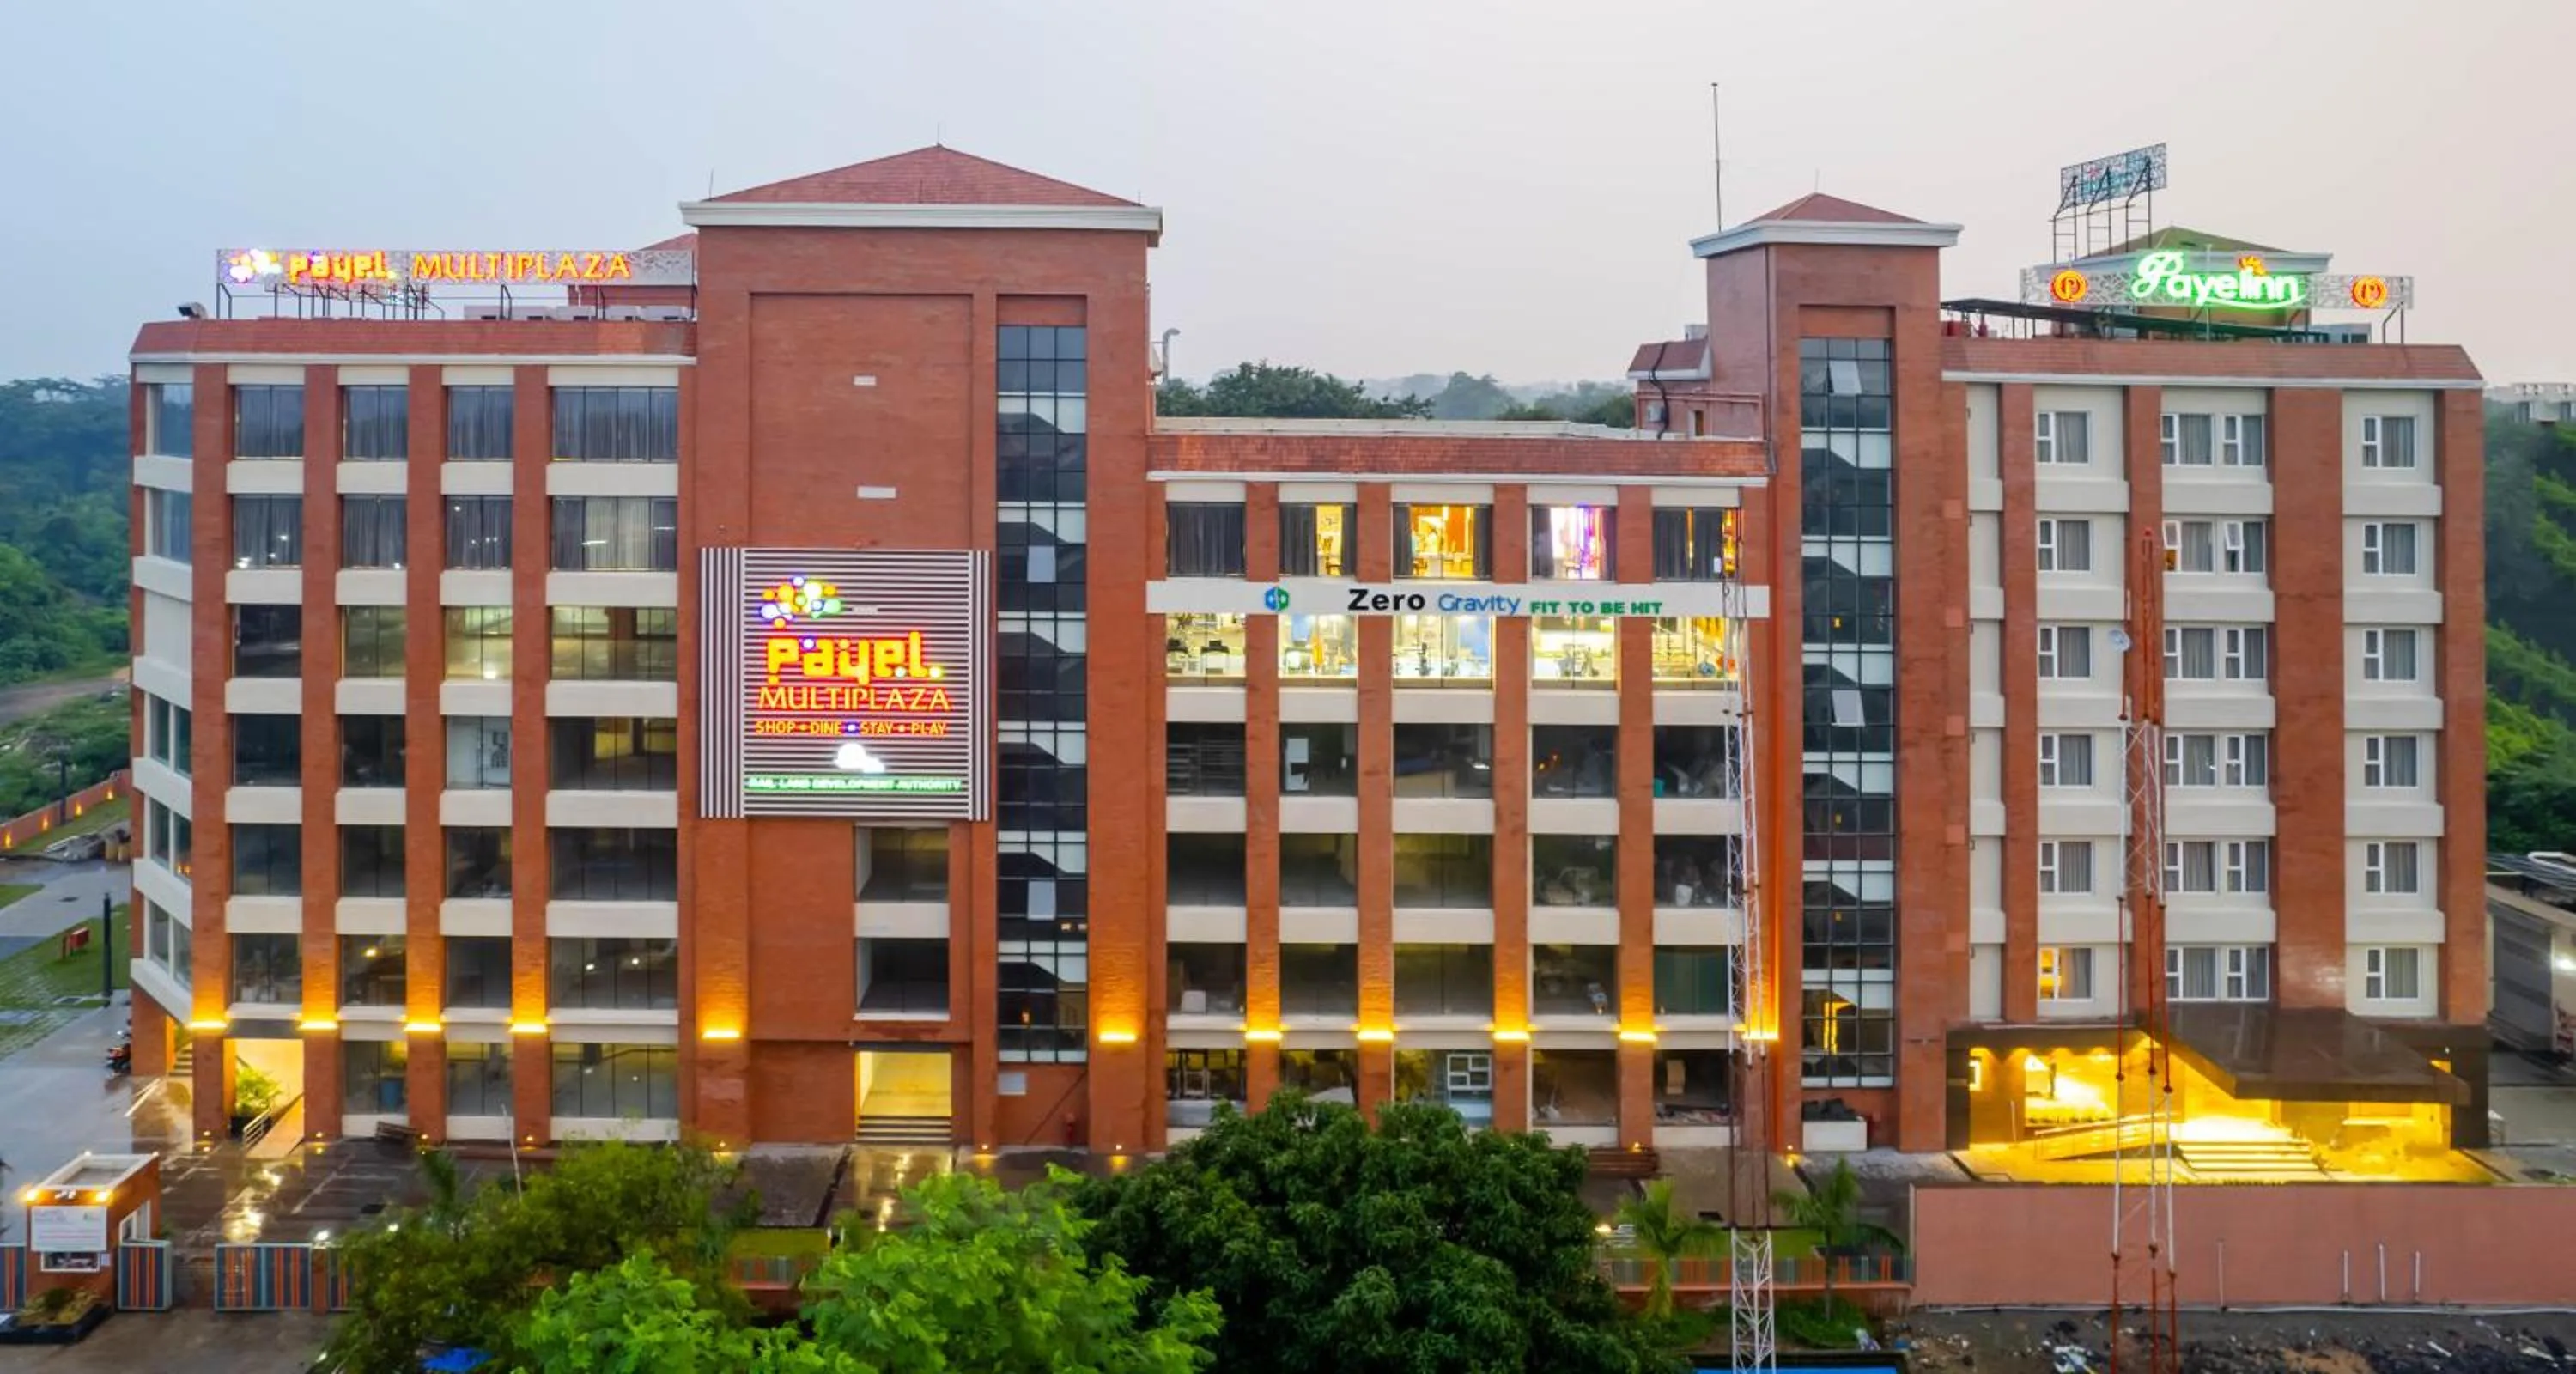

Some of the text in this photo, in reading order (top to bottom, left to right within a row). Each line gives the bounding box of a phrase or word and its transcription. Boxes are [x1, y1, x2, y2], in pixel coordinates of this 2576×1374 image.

[412, 253, 632, 280] MULTIPLAZA
[1347, 588, 1662, 615] Zero Gravity FIT TO BE HIT
[758, 687, 951, 711] MULTIPLAZA
[755, 721, 947, 736] SHOP DINE STAY PLAY
